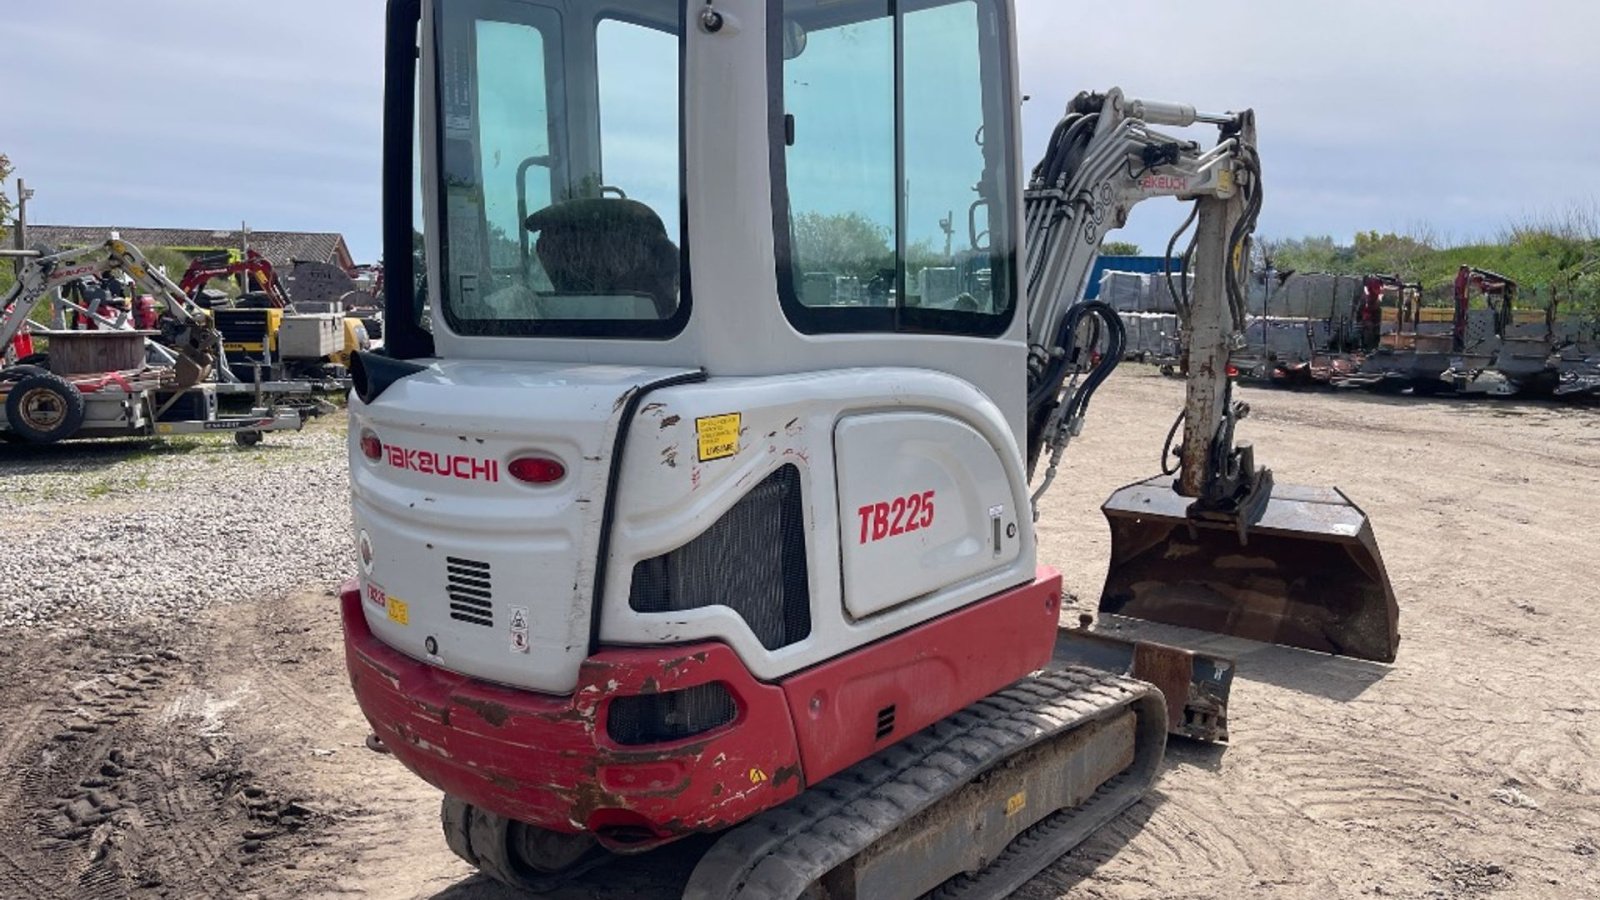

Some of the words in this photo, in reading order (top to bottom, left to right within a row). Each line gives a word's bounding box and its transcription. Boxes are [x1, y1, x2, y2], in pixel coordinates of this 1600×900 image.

[1138, 174, 1188, 191] AKEUCH
[383, 444, 498, 482] TAKEUCHI
[858, 490, 935, 545] TB225
